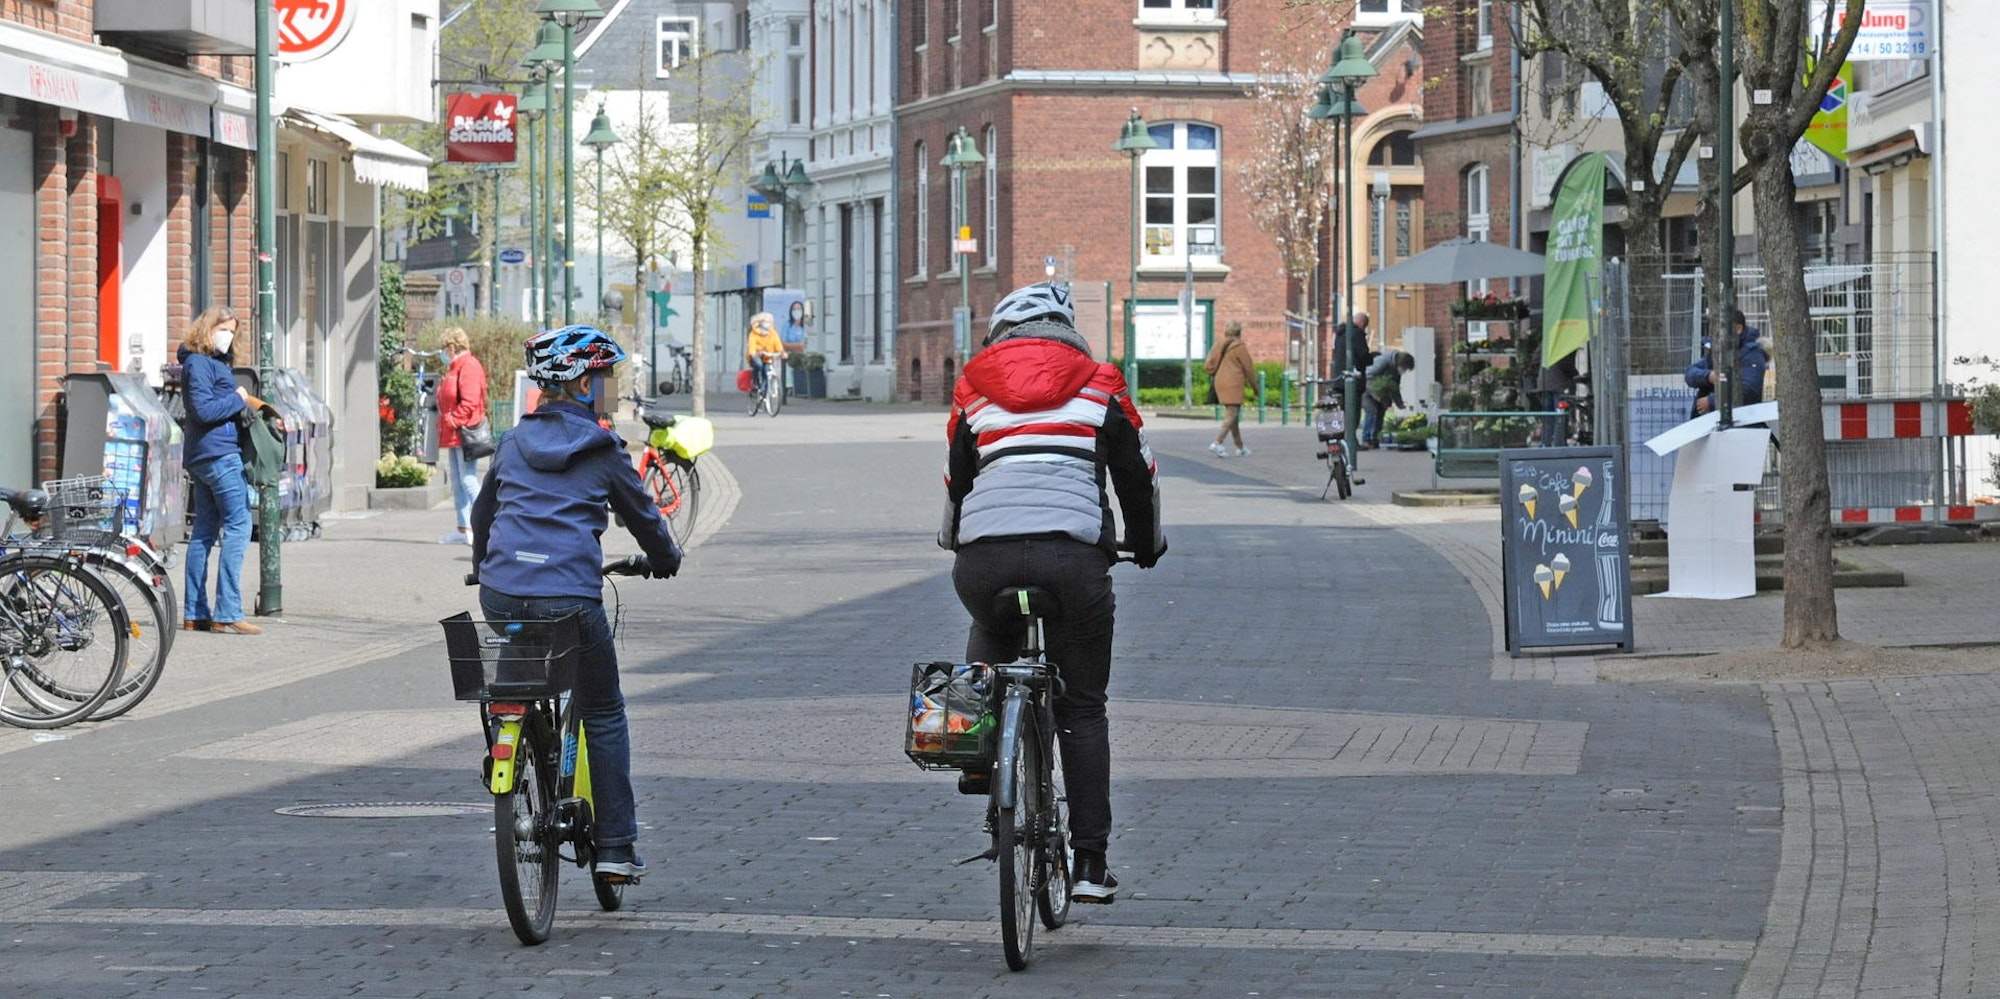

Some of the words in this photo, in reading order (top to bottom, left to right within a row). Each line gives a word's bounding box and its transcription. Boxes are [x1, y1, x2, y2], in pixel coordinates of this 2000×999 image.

[1861, 10, 1905, 30] Jung
[1880, 43, 1892, 54] 50
[1896, 43, 1909, 54] 32
[1913, 42, 1925, 54] 19
[454, 115, 510, 131] Bäcker
[449, 127, 514, 143] Schmidt
[1519, 517, 1594, 556] Minini
